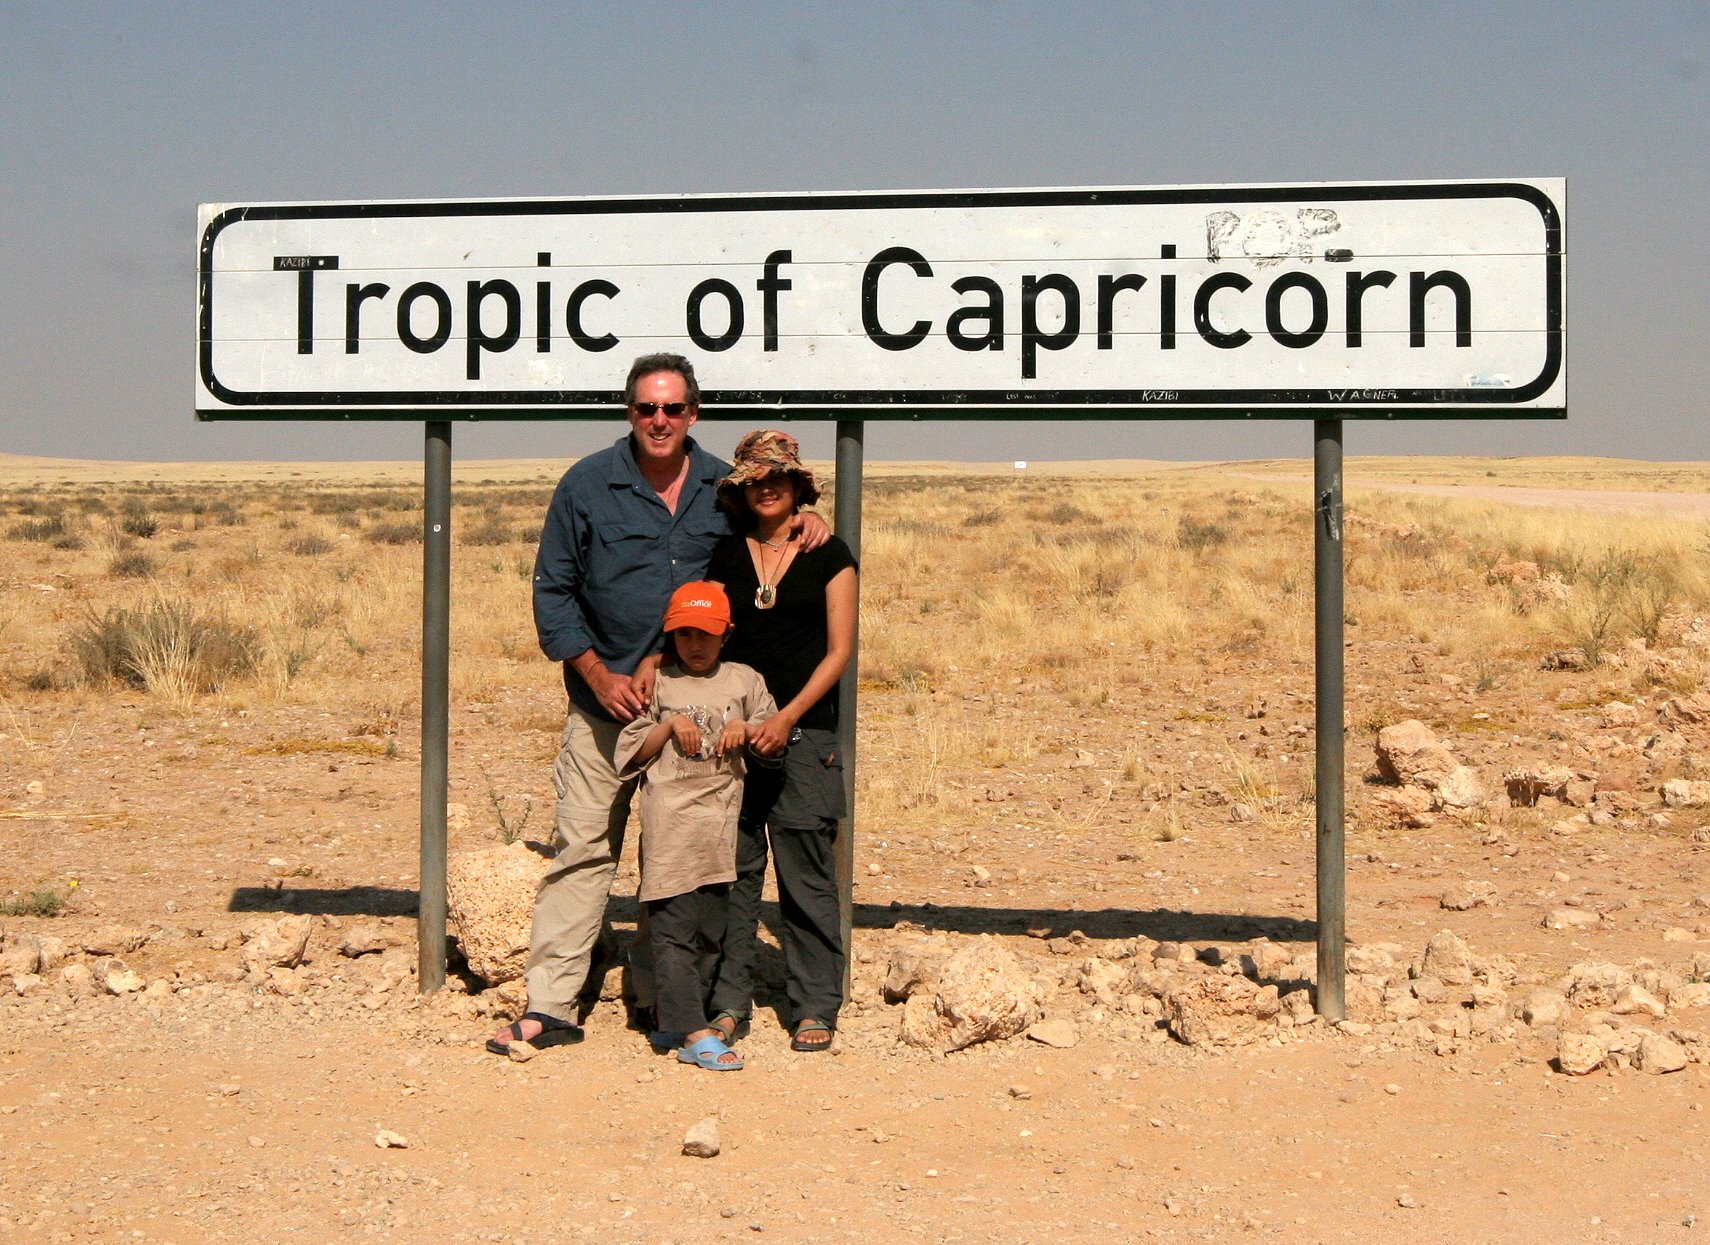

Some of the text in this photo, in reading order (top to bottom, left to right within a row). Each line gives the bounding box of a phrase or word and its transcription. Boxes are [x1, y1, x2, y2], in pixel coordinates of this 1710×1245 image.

[273, 244, 1472, 381] Tropic of Capricorn
